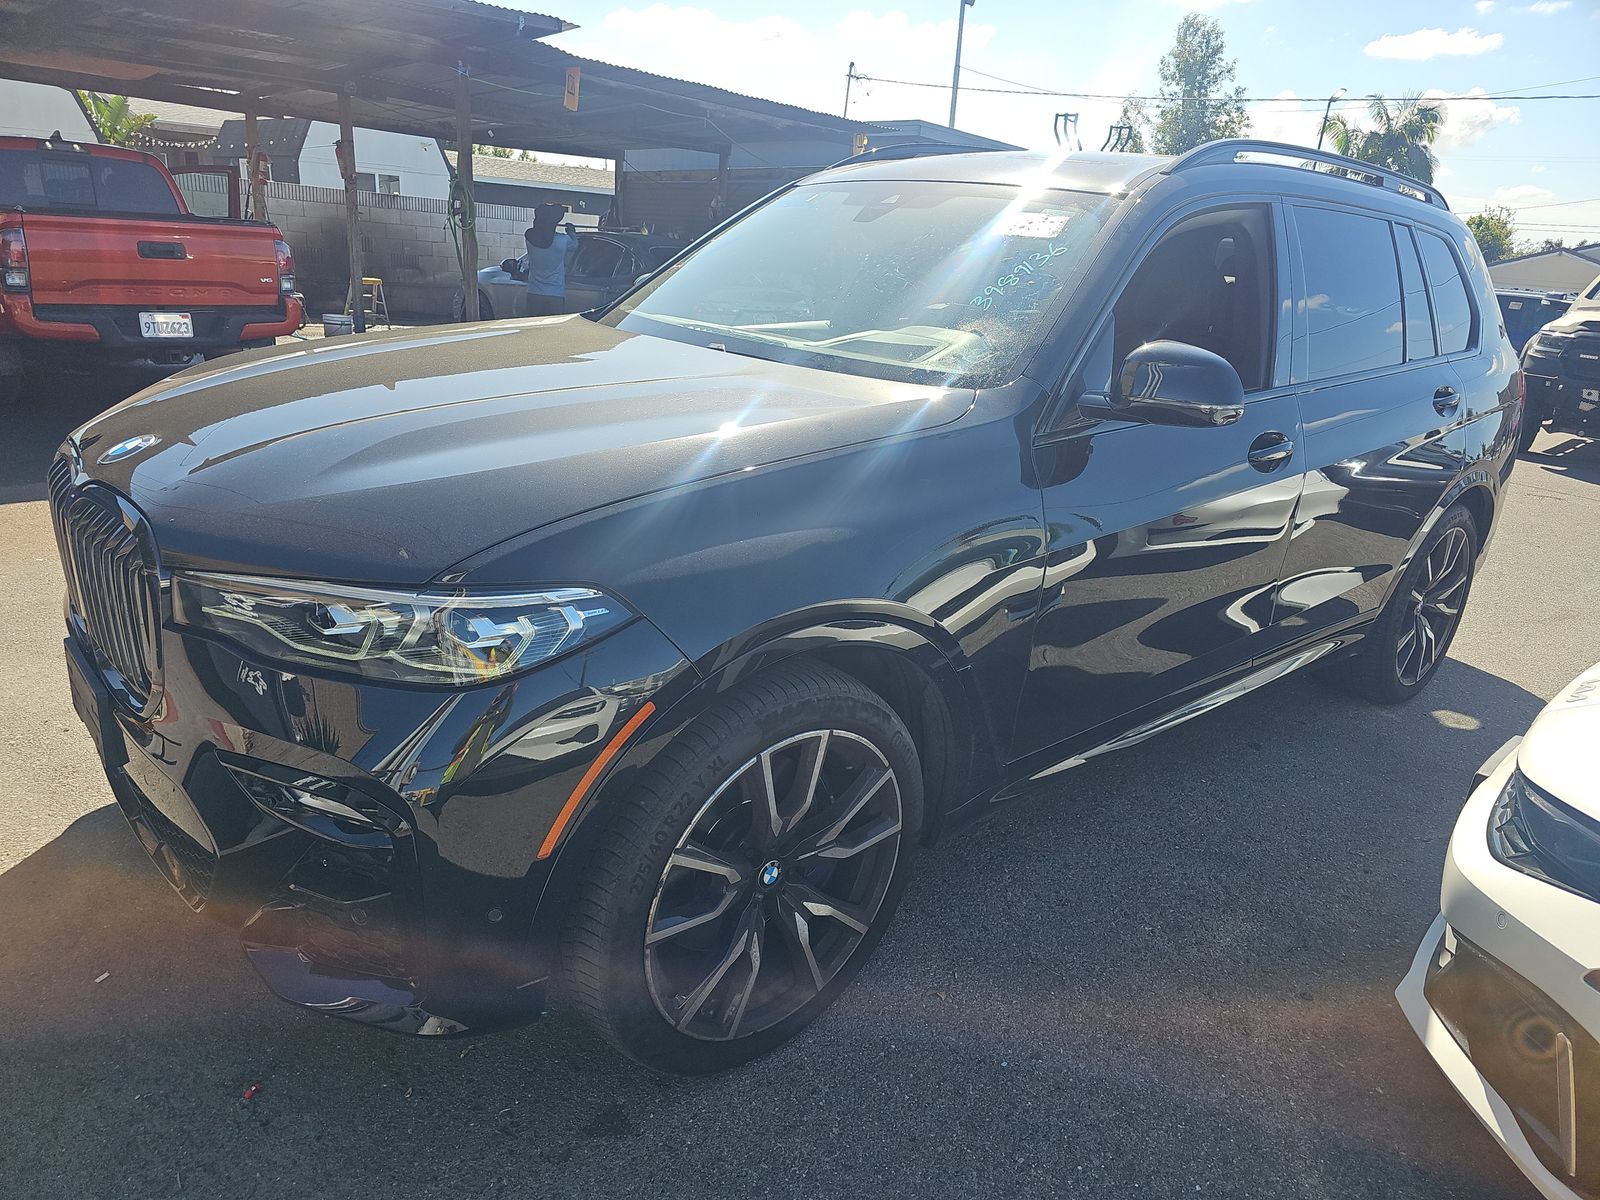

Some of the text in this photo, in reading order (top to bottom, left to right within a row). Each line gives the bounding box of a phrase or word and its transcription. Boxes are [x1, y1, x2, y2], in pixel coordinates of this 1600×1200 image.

[629, 830, 668, 895] 275/40
[663, 814, 679, 827] R
[673, 791, 695, 816] 22
[705, 755, 730, 776] XL
